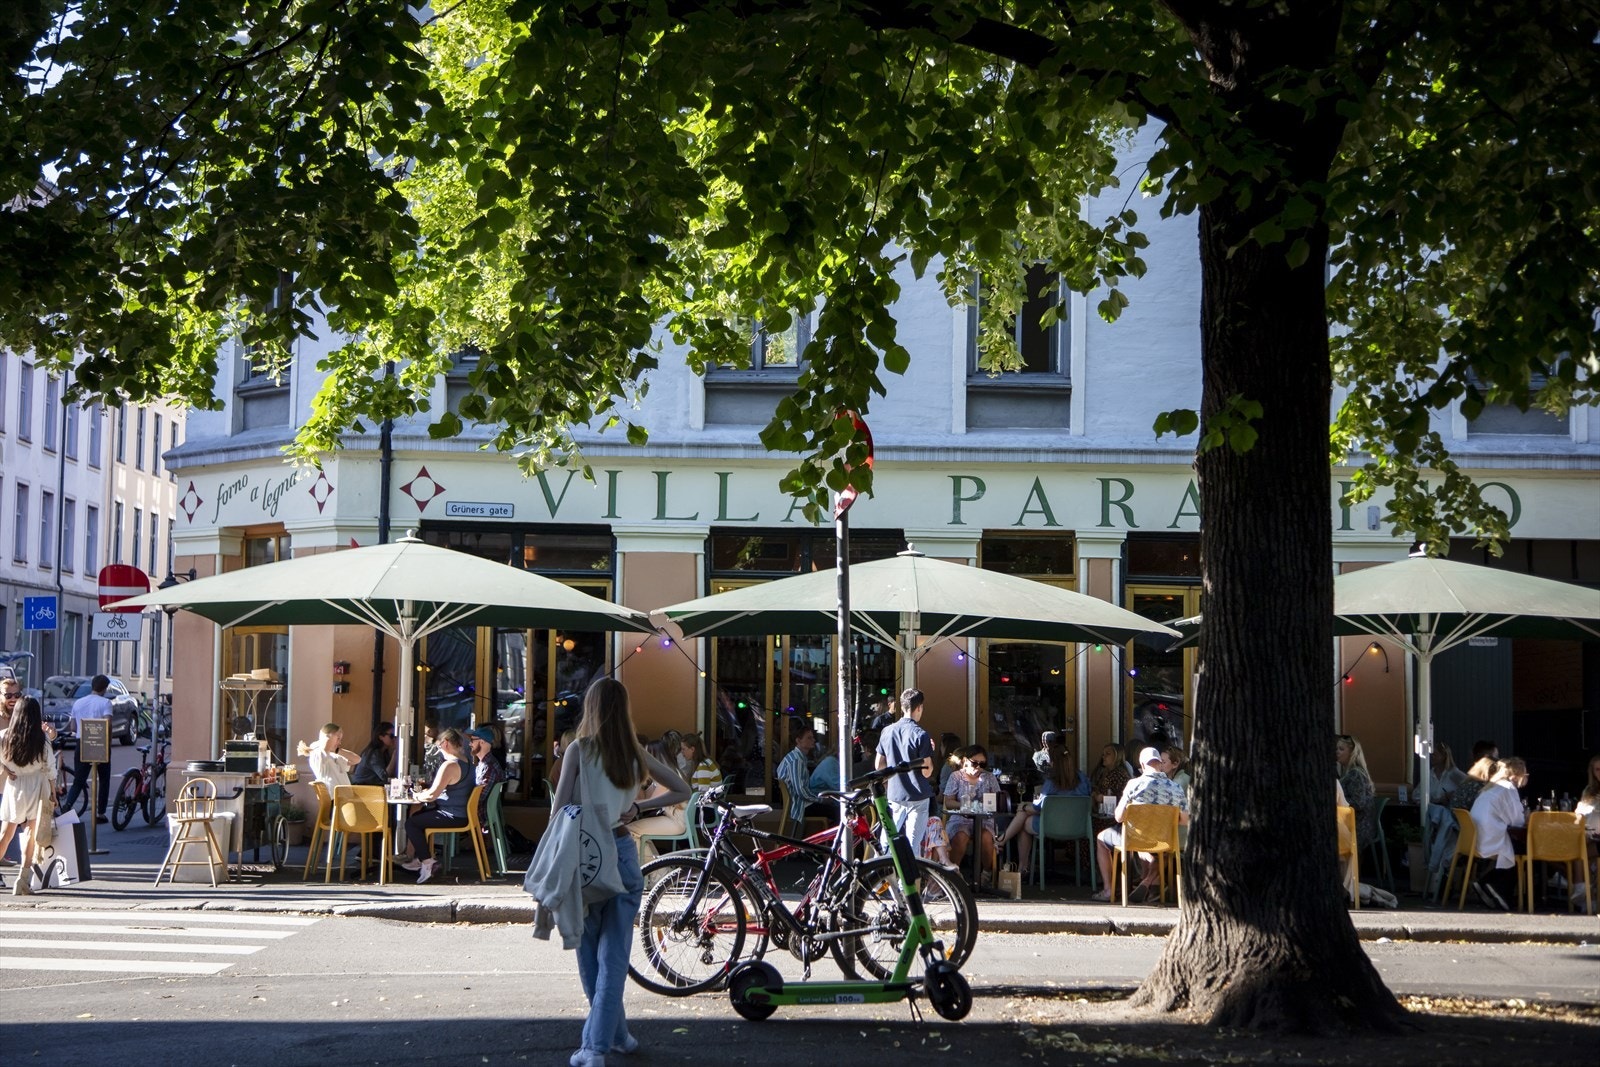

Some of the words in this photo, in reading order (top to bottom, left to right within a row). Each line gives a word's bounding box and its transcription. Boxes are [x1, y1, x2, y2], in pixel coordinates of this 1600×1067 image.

[211, 474, 249, 524] forno
[250, 485, 260, 503] a
[262, 470, 298, 518] legna
[451, 504, 485, 514] Grüners
[489, 506, 509, 516] gate
[947, 474, 1522, 533] PARAIO
